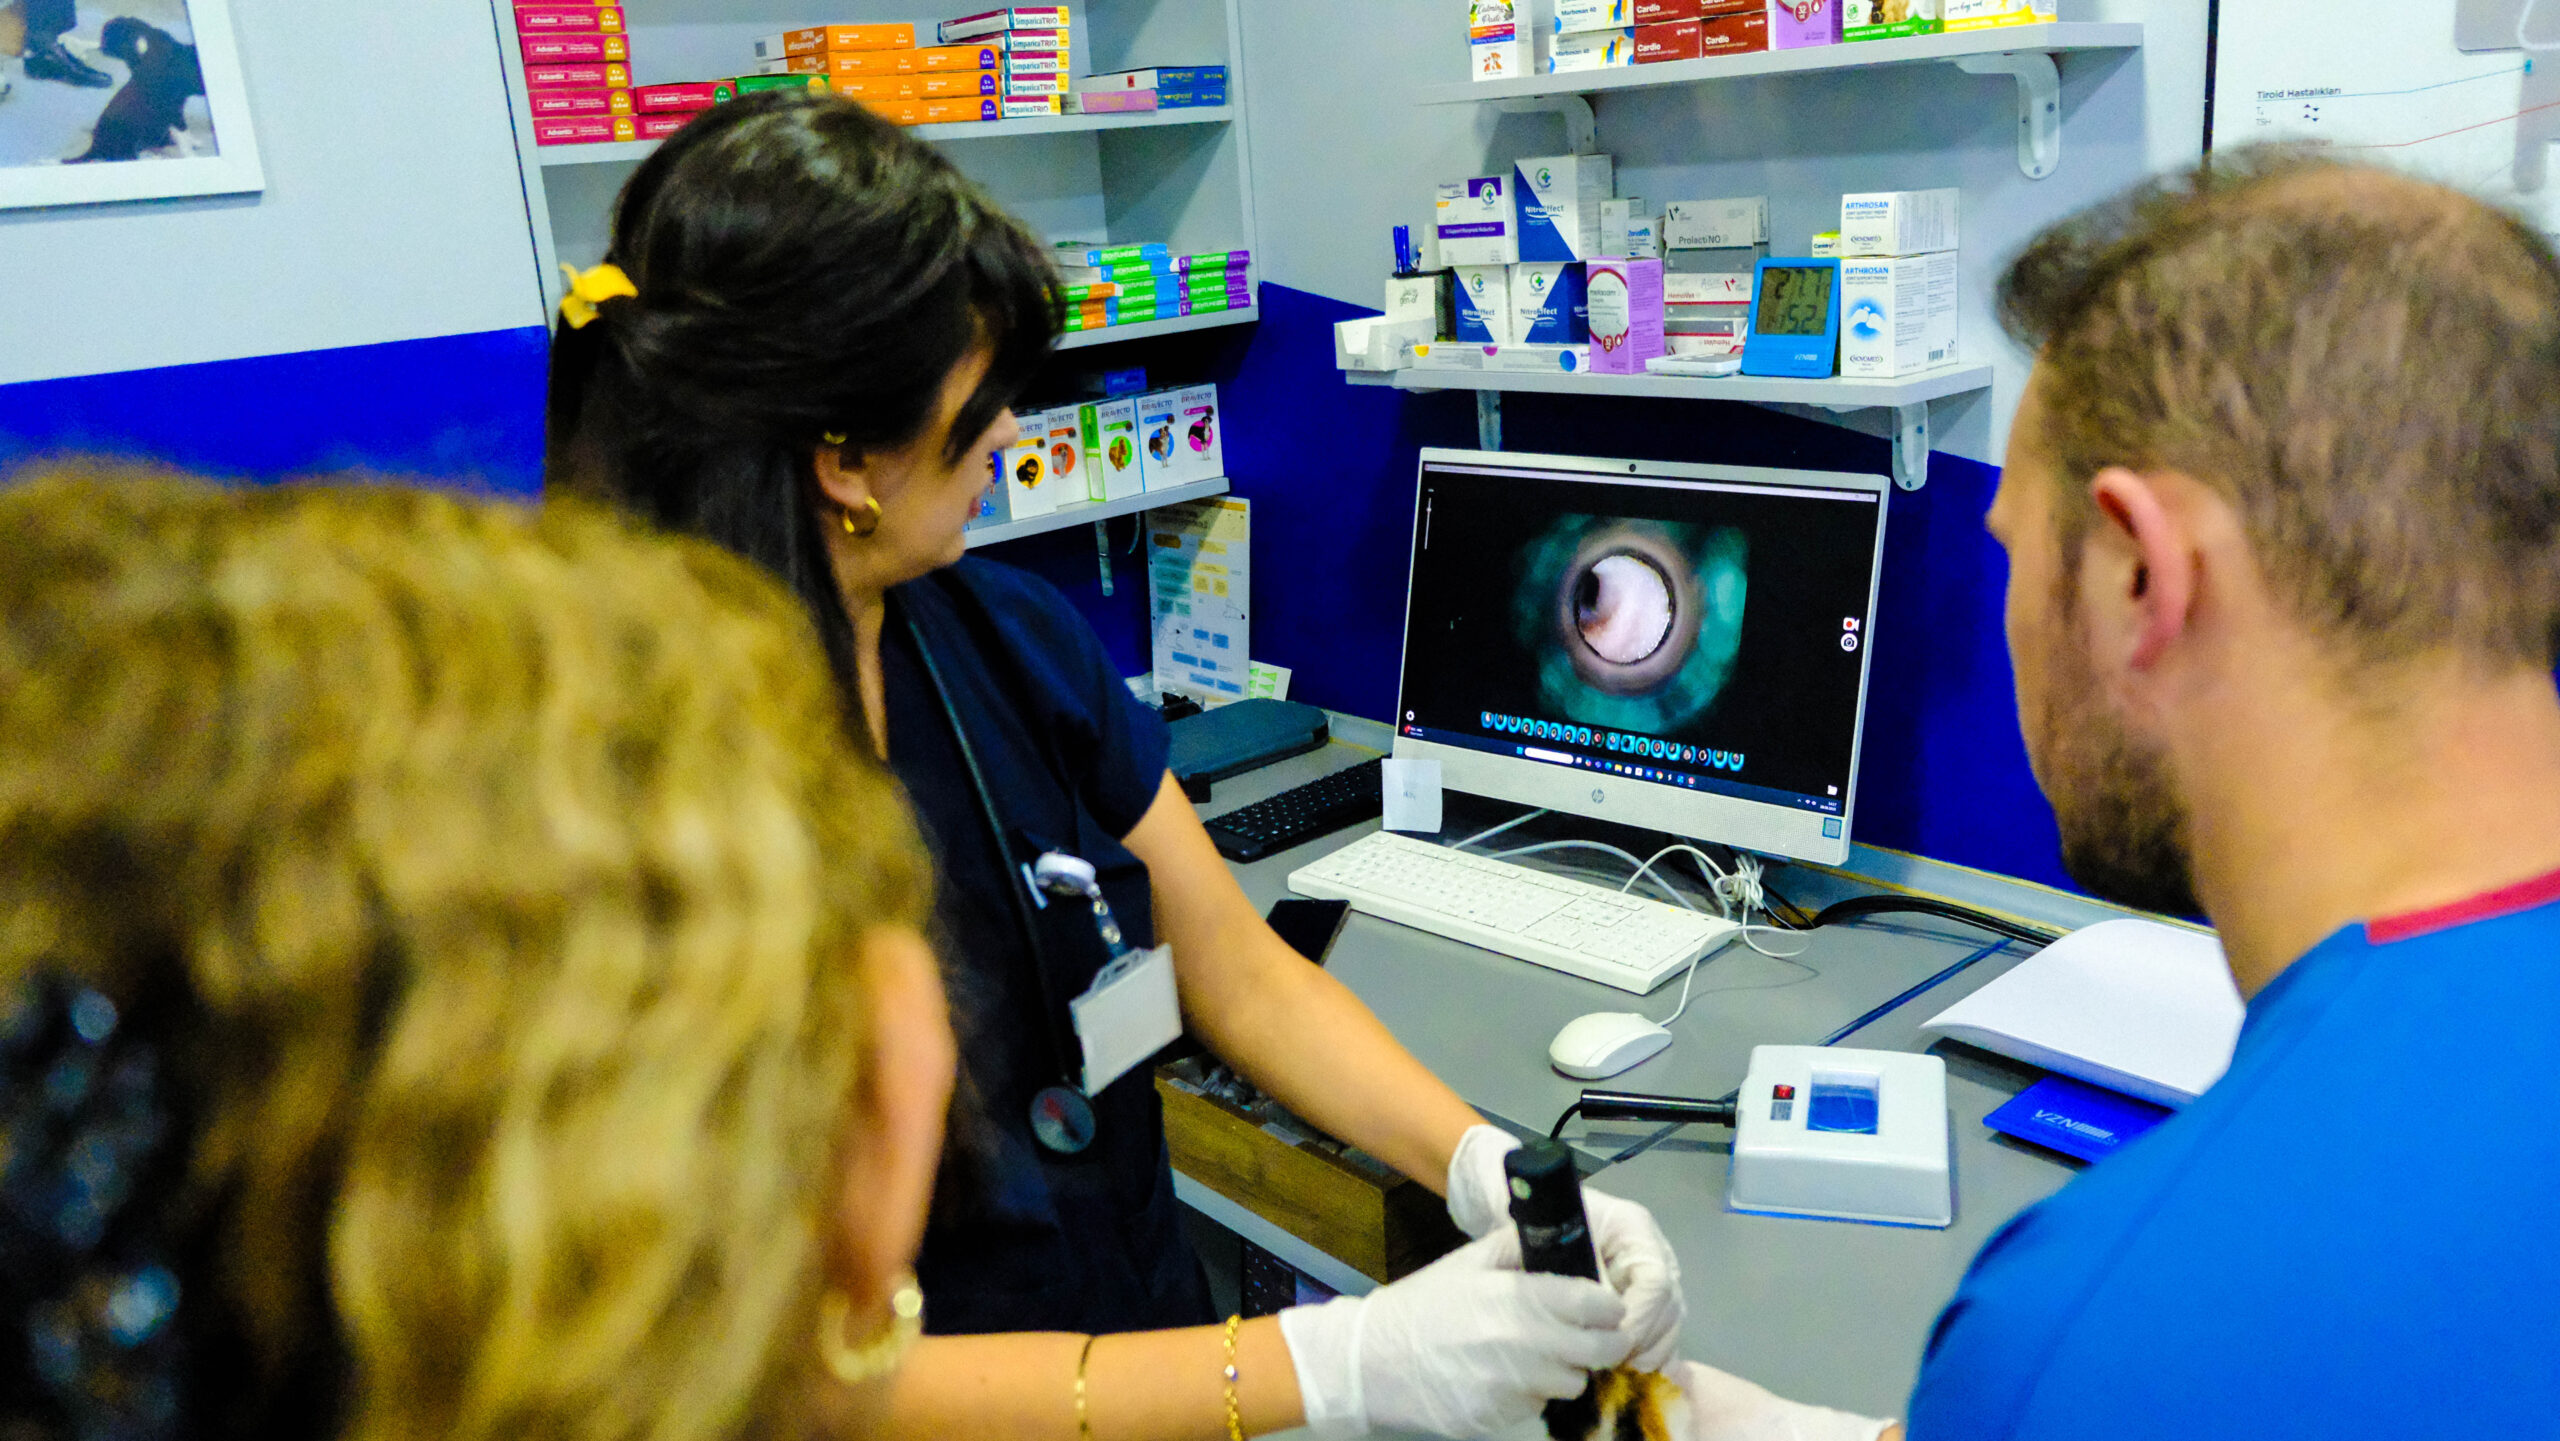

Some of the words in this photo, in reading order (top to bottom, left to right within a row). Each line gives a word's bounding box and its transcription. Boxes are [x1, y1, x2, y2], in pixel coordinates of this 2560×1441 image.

[1636, 4, 1660, 13] Cardio
[1705, 35, 1729, 45] Cardio
[1637, 43, 1661, 52] Cardio
[2257, 90, 2284, 99] Tiroid
[1525, 205, 1564, 213] NitroEffect
[1462, 308, 1495, 316] NitroEffect
[1520, 308, 1557, 316] NitroEffect
[1181, 392, 1212, 403] BRAVECTO
[1142, 400, 1172, 410] BRAVECTO
[1101, 407, 1131, 418] BRAVECTO
[1018, 423, 1043, 433] AVECTO
